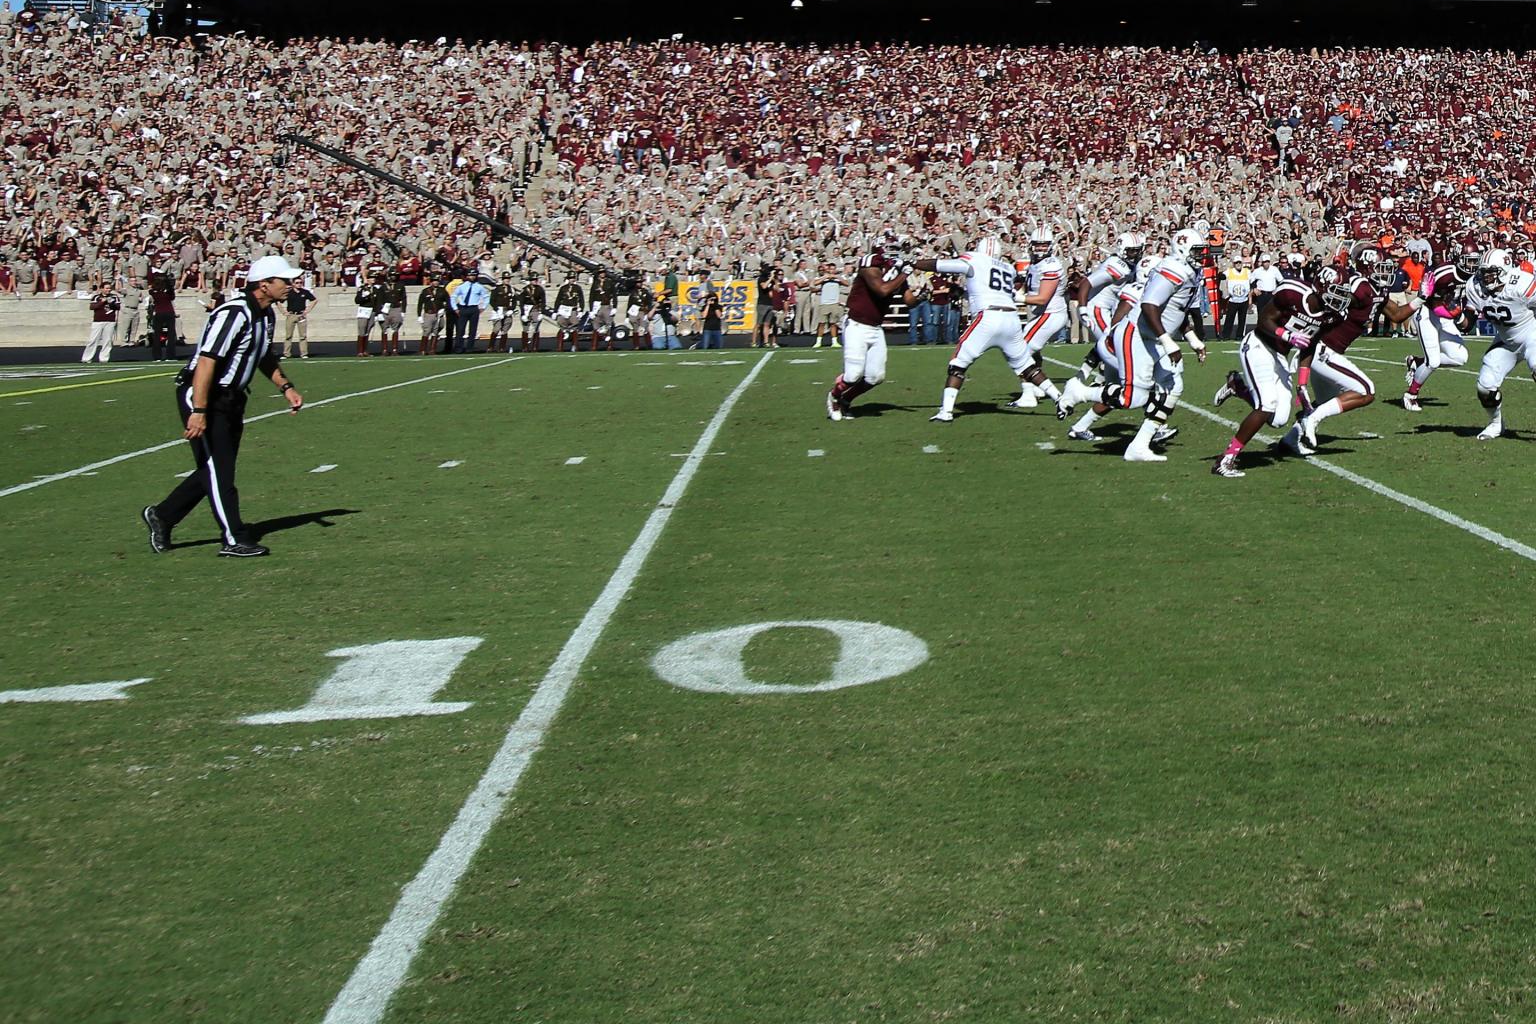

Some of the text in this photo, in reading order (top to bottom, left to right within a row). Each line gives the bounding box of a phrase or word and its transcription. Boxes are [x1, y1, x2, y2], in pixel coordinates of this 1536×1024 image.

[1209, 230, 1223, 246] 3
[989, 267, 1012, 293] 65
[238, 636, 485, 725] 1
[650, 618, 931, 694] 0
